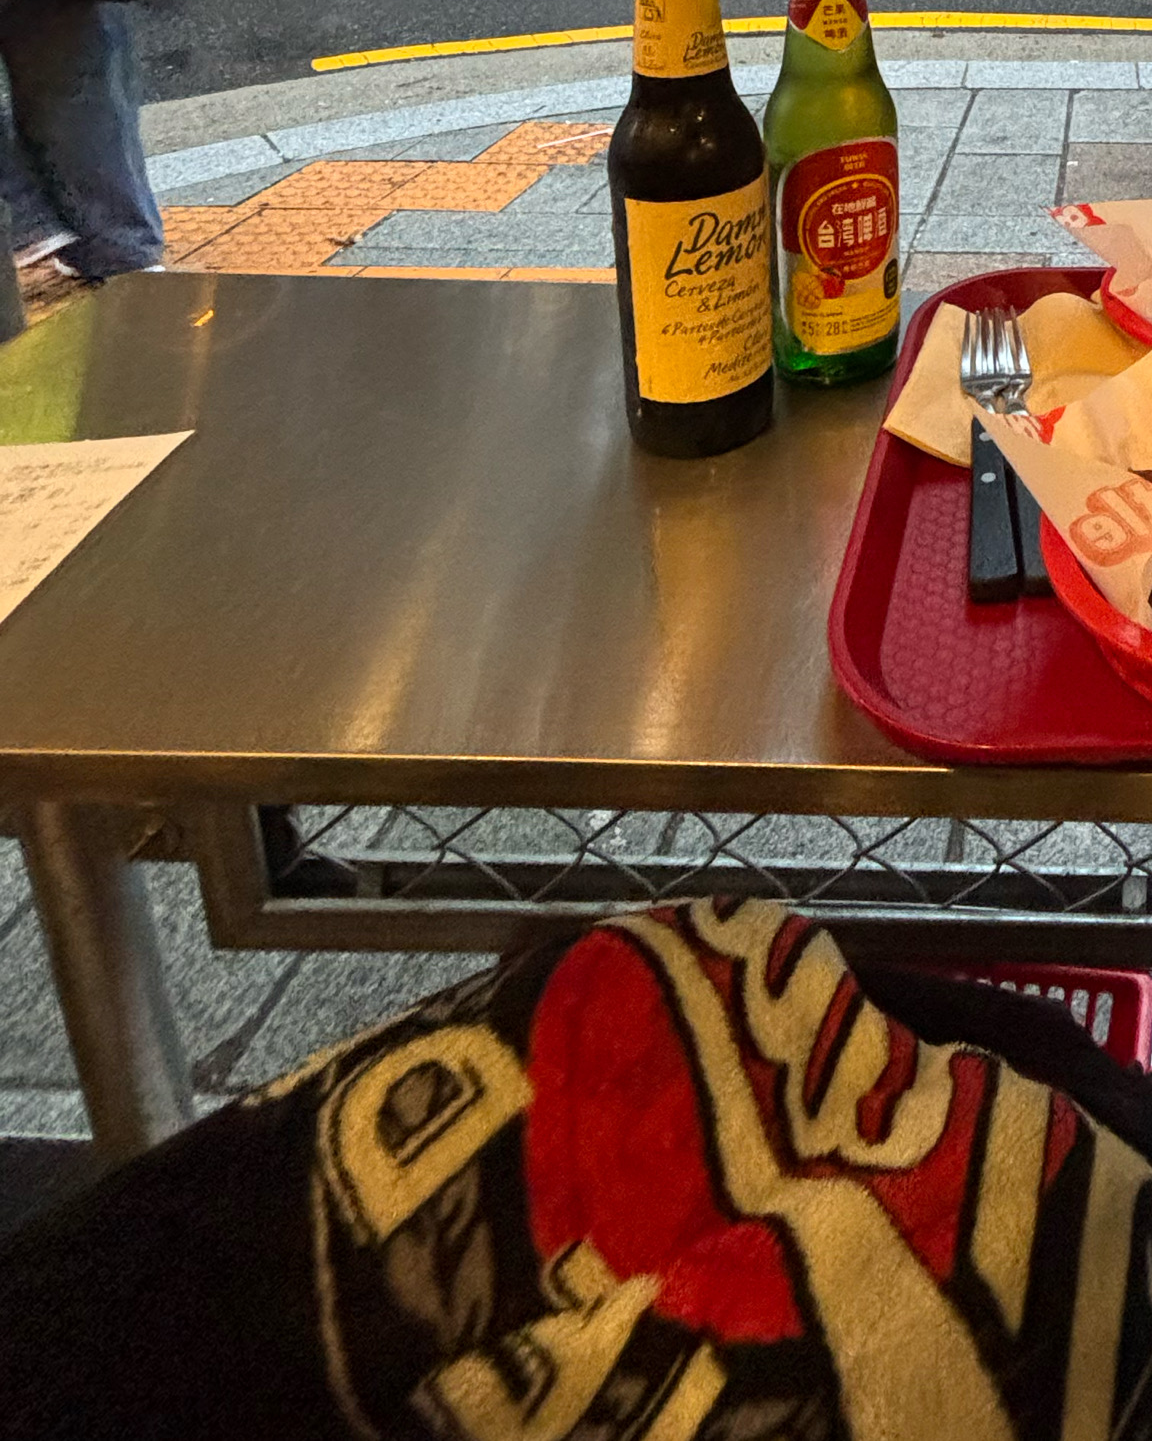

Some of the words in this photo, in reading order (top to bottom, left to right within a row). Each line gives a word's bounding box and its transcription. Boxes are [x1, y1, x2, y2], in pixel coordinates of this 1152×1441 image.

[665, 276, 735, 298] Cerveza
[697, 297, 711, 313] &
[808, 322, 815, 337] 5
[825, 321, 840, 336] 28
